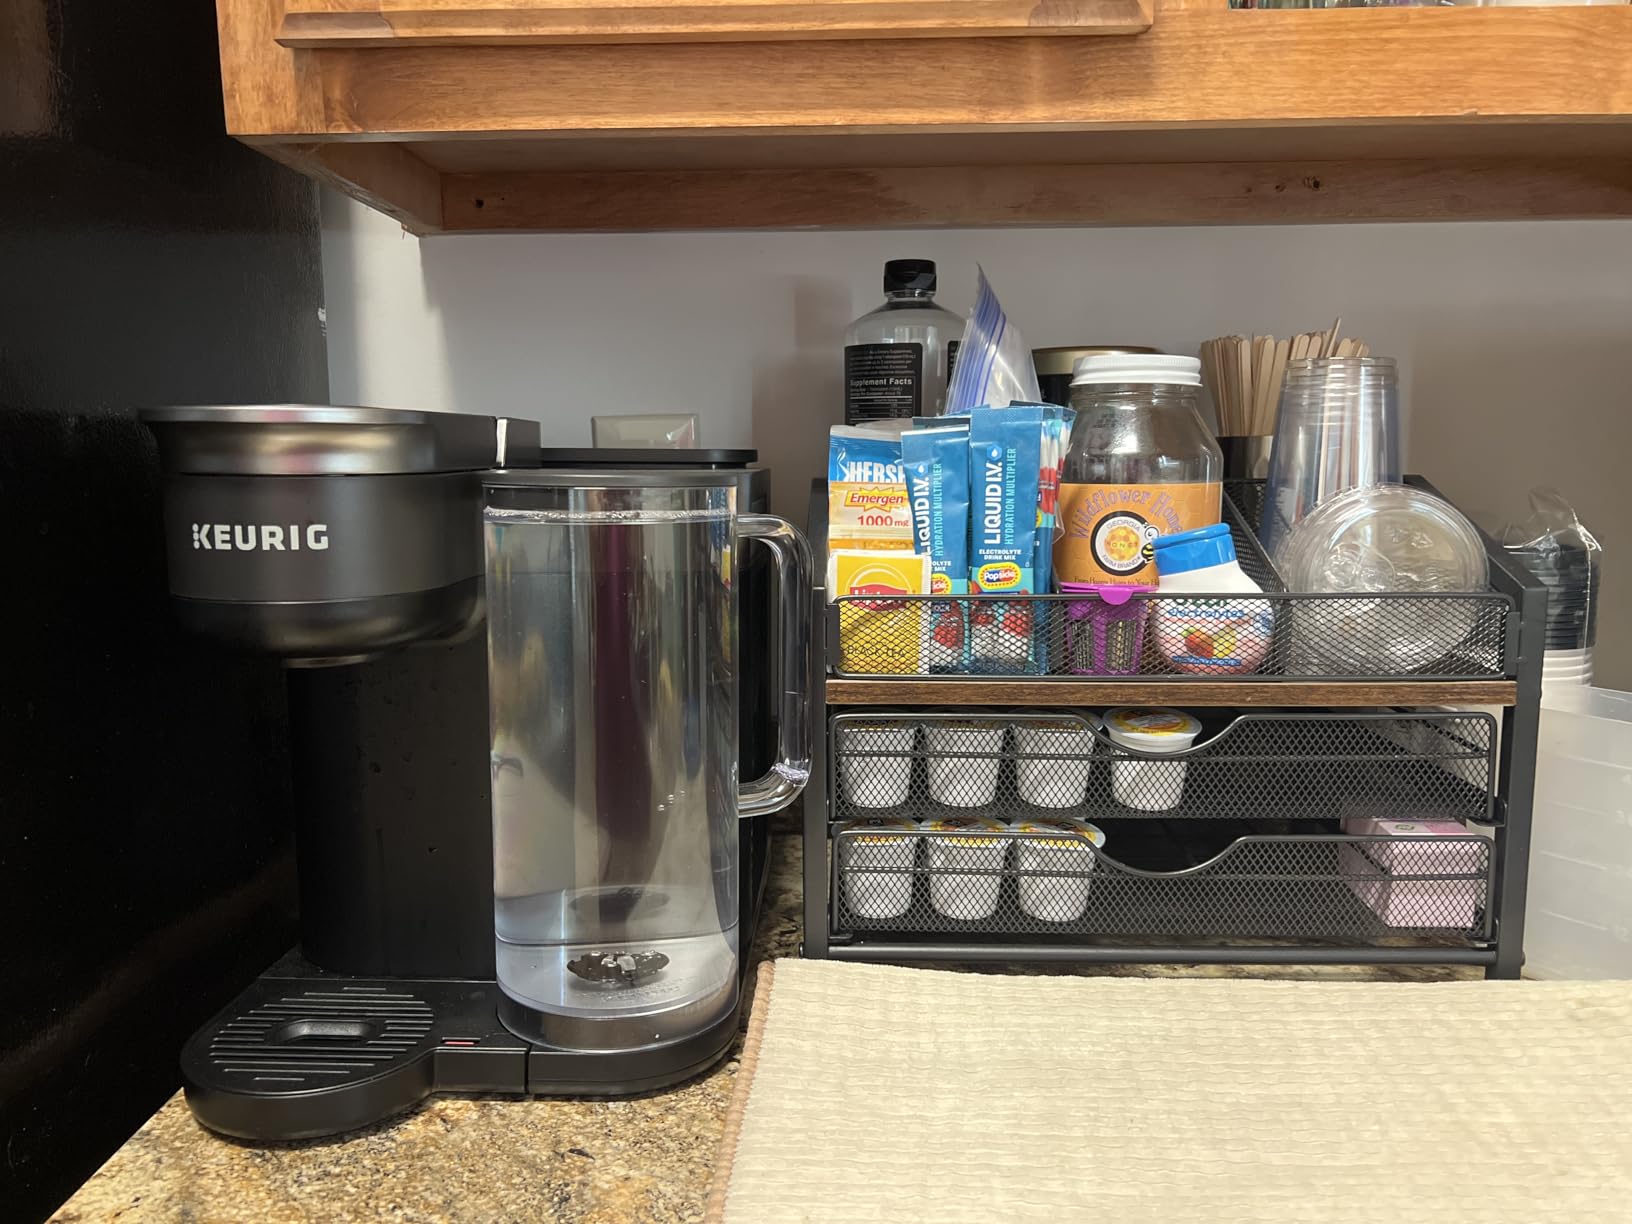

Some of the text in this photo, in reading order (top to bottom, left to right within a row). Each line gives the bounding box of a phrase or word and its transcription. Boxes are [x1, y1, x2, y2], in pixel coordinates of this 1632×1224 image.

[849, 377, 913, 388] Supplement Facts
[933, 463, 944, 557] HYDRATION MULTIPLIER
[984, 483, 1003, 545] LIQUID
[1004, 448, 1017, 545] HYDRATION MULTIPLIER
[1072, 488, 1151, 539] Wildflower
[192, 523, 329, 550] KEURIG
[857, 515, 893, 527] 1000
[1106, 519, 1140, 532] GEORGIA
